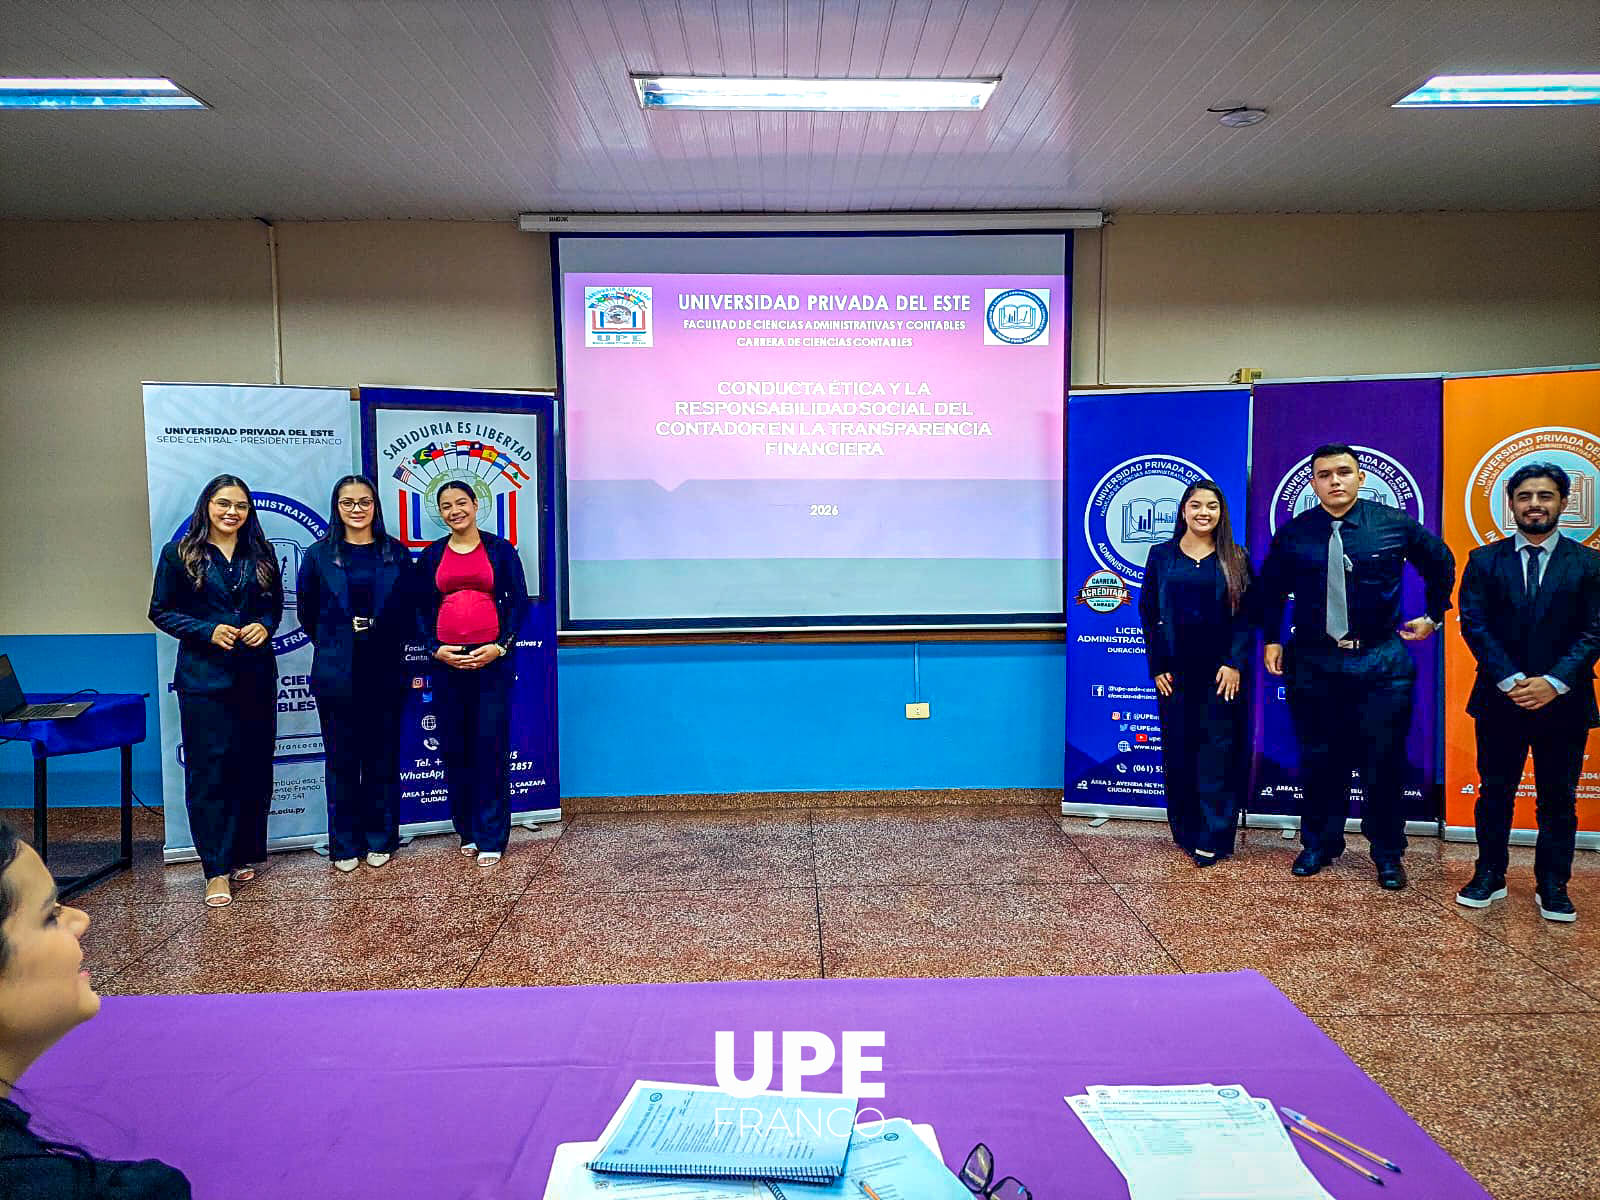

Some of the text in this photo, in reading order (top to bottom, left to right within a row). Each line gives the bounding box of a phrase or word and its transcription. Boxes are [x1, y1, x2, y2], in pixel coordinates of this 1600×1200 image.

[678, 293, 972, 312] UNIVERSIDAD PRIVADA DEL ESTE
[683, 319, 966, 332] FACULTAD DE CIENCIAS ADMINISTRATIVAS Y CONTABLES
[736, 337, 913, 348] CARRERA DE CIENCIAS CONTABLES
[716, 378, 932, 397] CONDUCTA ÉTICA Y LA
[674, 400, 975, 417] RESPONSABILIDAD SOCIAL DEL
[164, 427, 335, 438] UNIVERSIDAD PRIVADA DEL ESTE
[655, 420, 992, 437] CONTADOR EN LA TRANSPARENCIA
[156, 435, 183, 444] SEDE
[186, 435, 232, 444] CENTRAL
[240, 437, 300, 448] PRESIDENTE
[302, 437, 342, 446] FRANCO
[383, 421, 532, 463] SABIDURIA ES LIBERTAD
[765, 441, 886, 457] FINANCIERA
[1476, 437, 1534, 487] UNIVERSIDAD
[1535, 434, 1584, 447] PRIVADA
[1094, 463, 1143, 508] UNIVERSIDAD
[1144, 460, 1186, 475] PRIVADA
[1280, 463, 1312, 502] UNIVERS
[1358, 453, 1379, 468] ADA
[1378, 459, 1397, 478] DEL
[1395, 475, 1414, 501] ESTE
[809, 504, 839, 517] 2026
[1096, 541, 1146, 580] ADMINISTRAC
[1091, 577, 1118, 585] CARRERA
[1081, 587, 1128, 598] ACREDITADA
[1107, 646, 1146, 655] DURACIÓN
[277, 700, 316, 713] BLES
[415, 758, 431, 768] Tel.
[1133, 764, 1154, 774] (061)
[515, 778, 546, 788] CAAZAPÁ
[1116, 780, 1143, 788] AVENIDA
[430, 788, 449, 796] AVEN
[1107, 786, 1132, 795] CIUDAD
[420, 795, 448, 804] CIUDAD
[271, 807, 306, 816] e.edu.py
